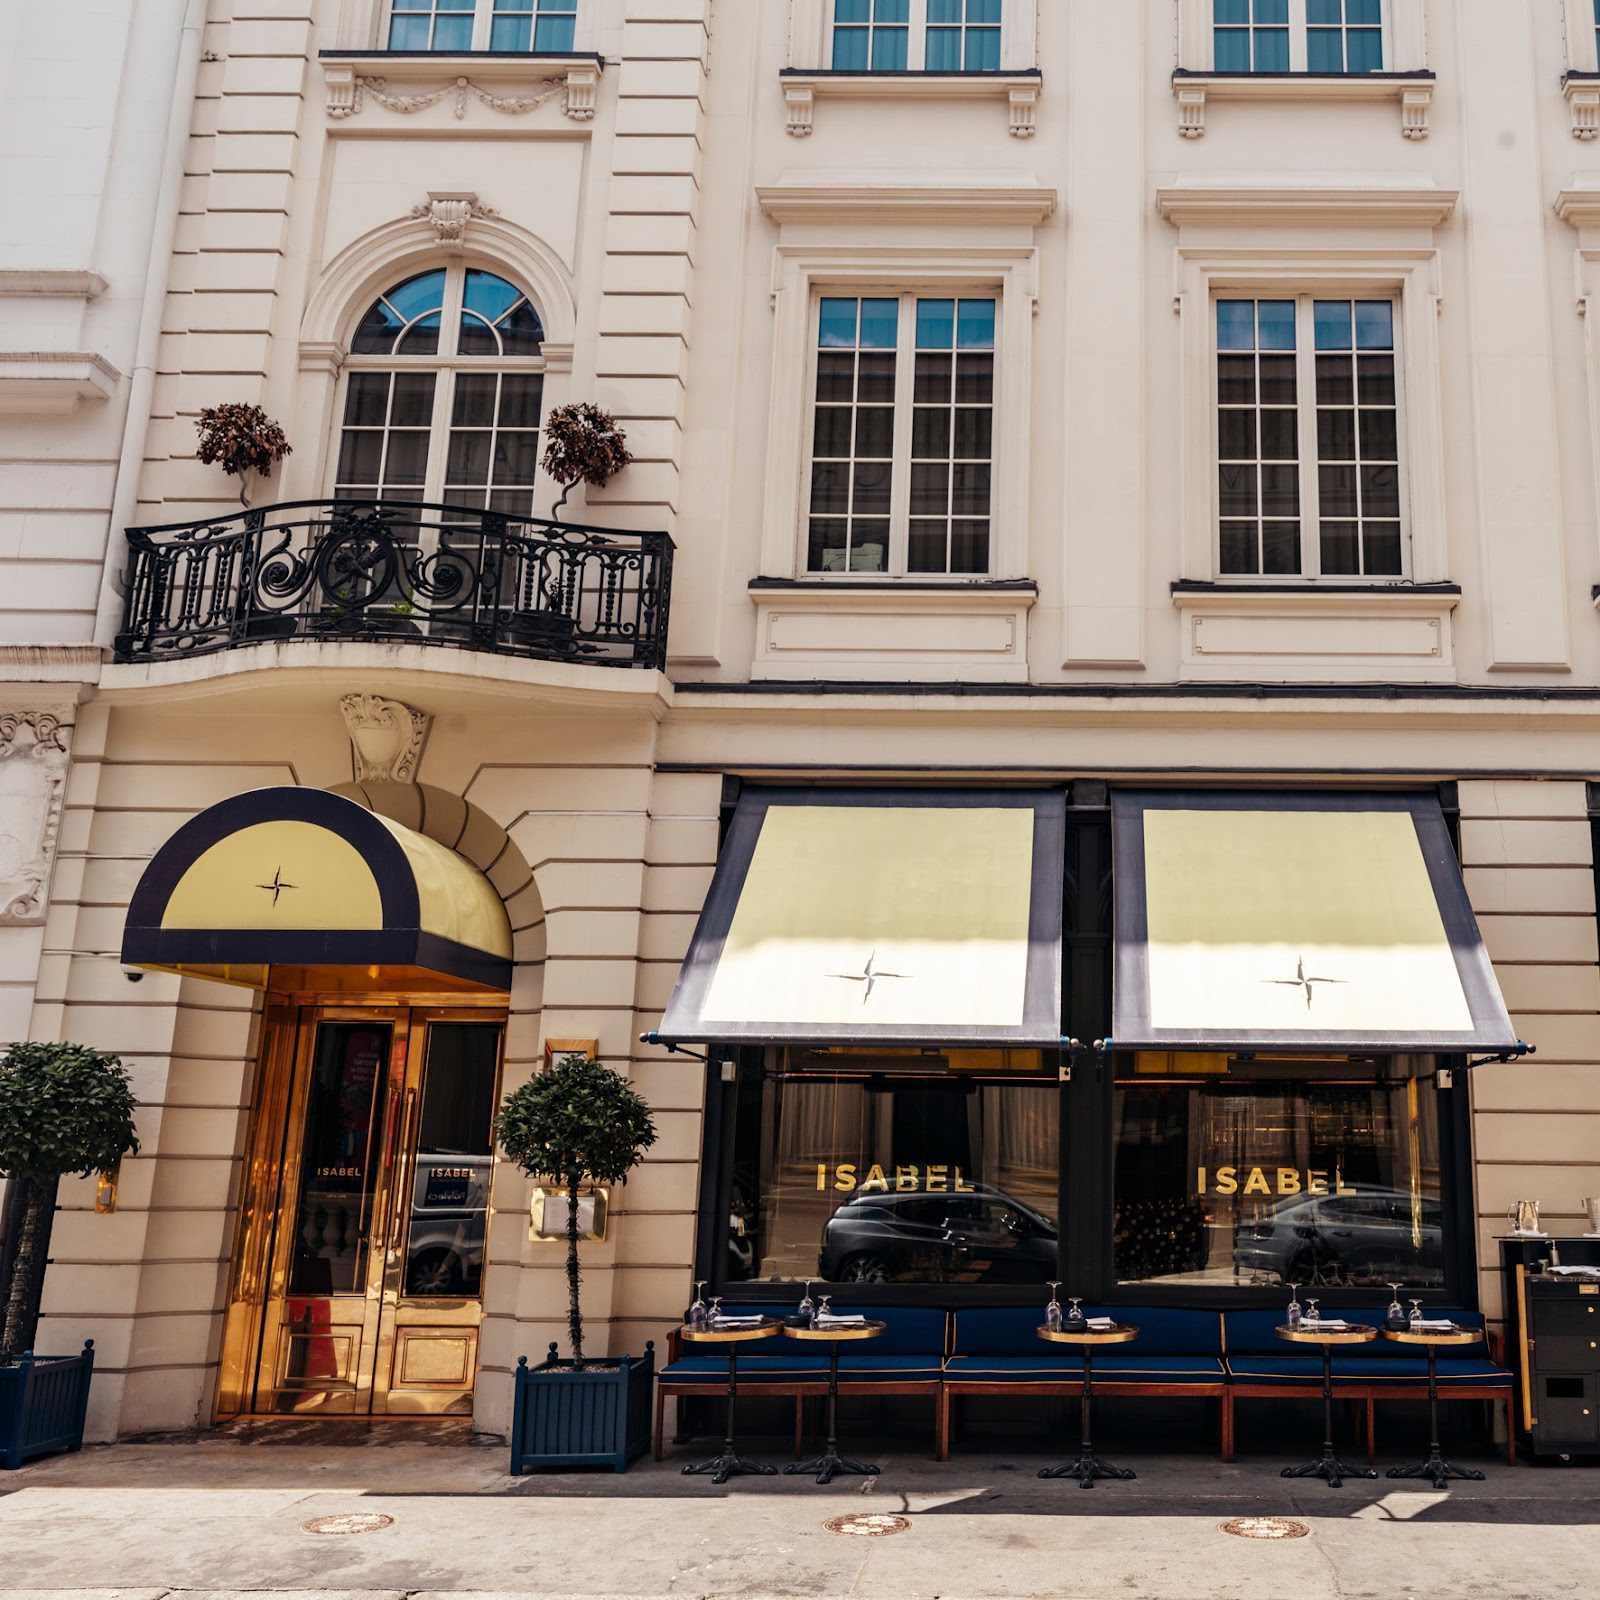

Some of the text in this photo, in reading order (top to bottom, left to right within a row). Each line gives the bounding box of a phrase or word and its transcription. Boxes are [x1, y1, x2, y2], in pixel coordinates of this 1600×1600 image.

[317, 1167, 361, 1176] ISABEL
[430, 1168, 476, 1177] ISABEL
[816, 1163, 975, 1192] ISABEL
[1197, 1166, 1357, 1195] ISABEL
